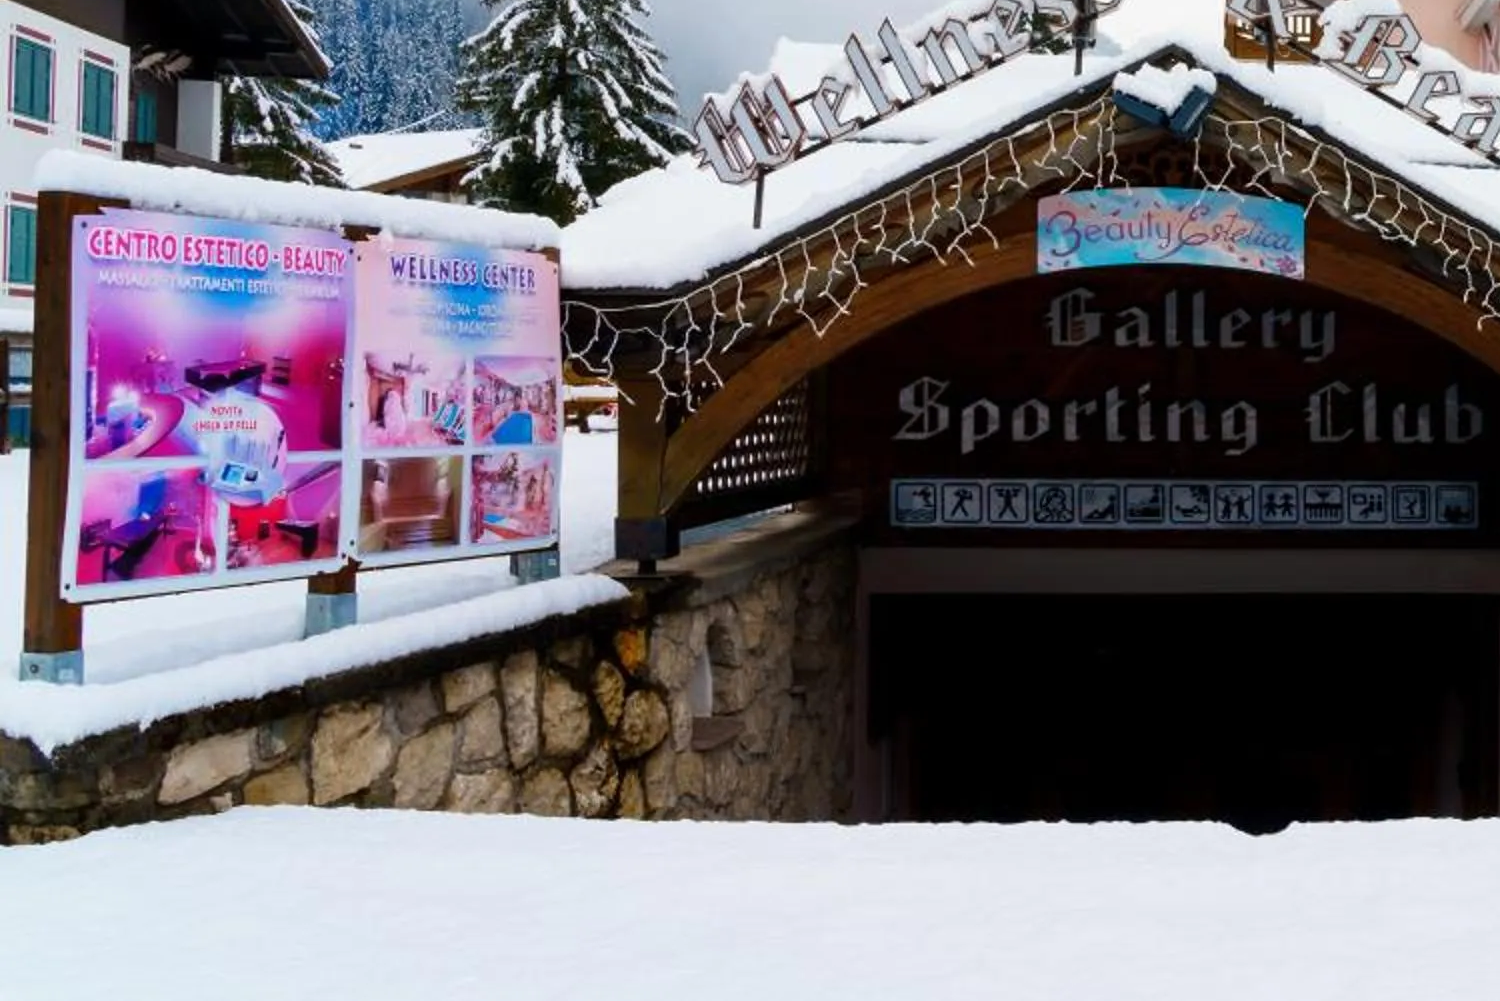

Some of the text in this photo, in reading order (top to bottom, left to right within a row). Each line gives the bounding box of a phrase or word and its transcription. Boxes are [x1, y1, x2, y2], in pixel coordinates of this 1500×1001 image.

[88, 228, 178, 263] CENTRO
[182, 236, 270, 270] ESTETICO
[282, 245, 347, 275] BEAUTY
[1046, 204, 1295, 261] Beauty Estetica
[390, 254, 537, 289] WELLNESS CENTER
[1041, 286, 1338, 364] Gallery
[891, 375, 1484, 457] Sporting Club
